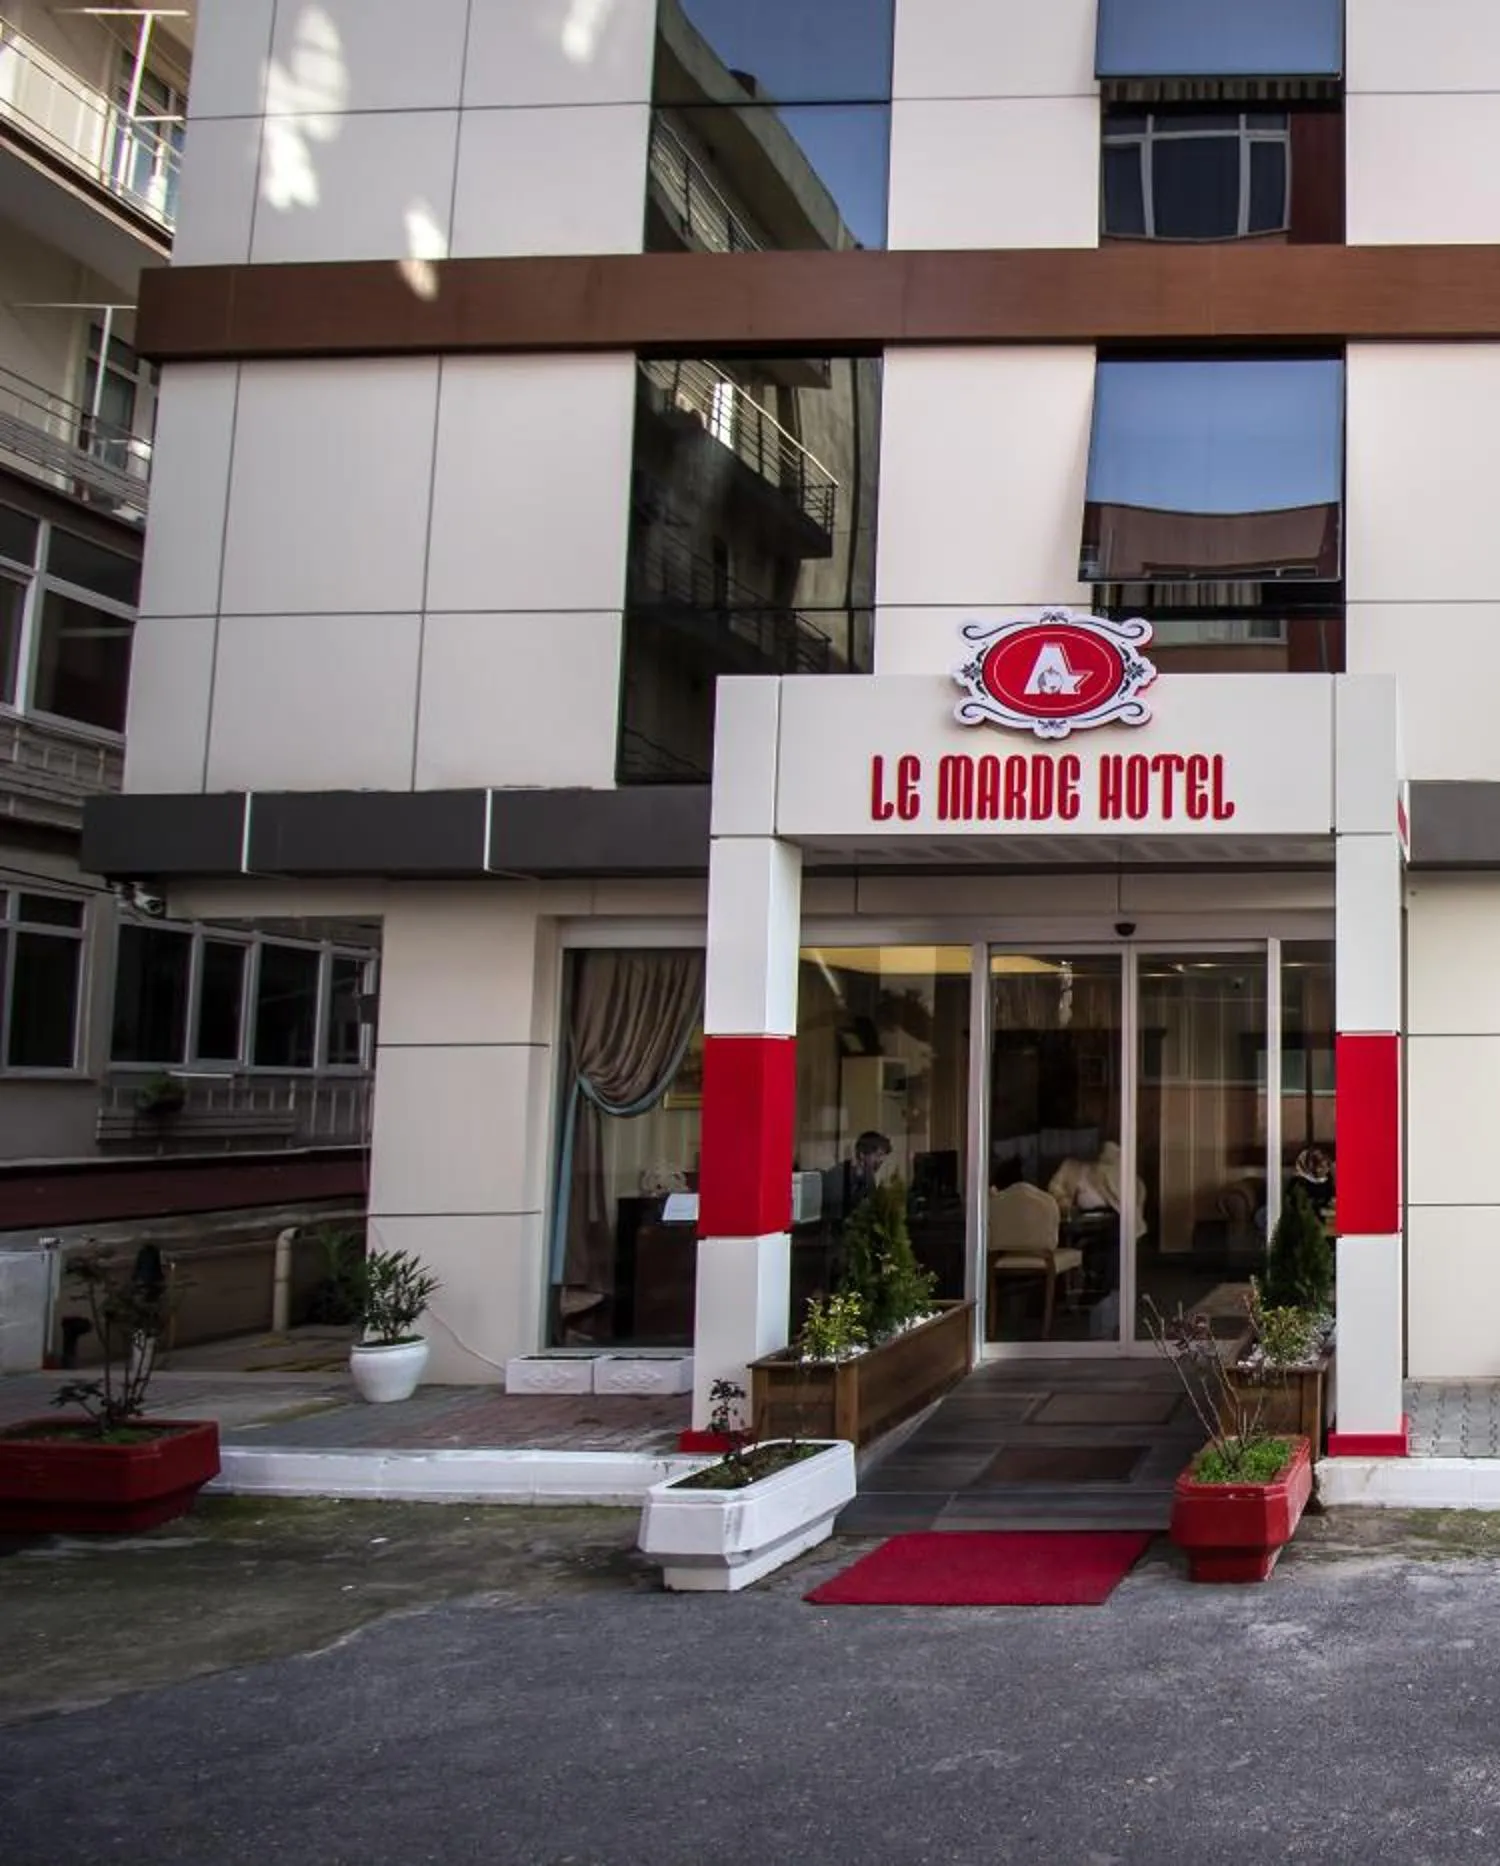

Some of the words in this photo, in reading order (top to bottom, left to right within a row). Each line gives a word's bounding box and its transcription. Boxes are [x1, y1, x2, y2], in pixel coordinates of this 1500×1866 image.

[871, 753, 921, 821] LE
[937, 752, 1082, 822] MARDE
[1099, 752, 1237, 821] HOTEL
